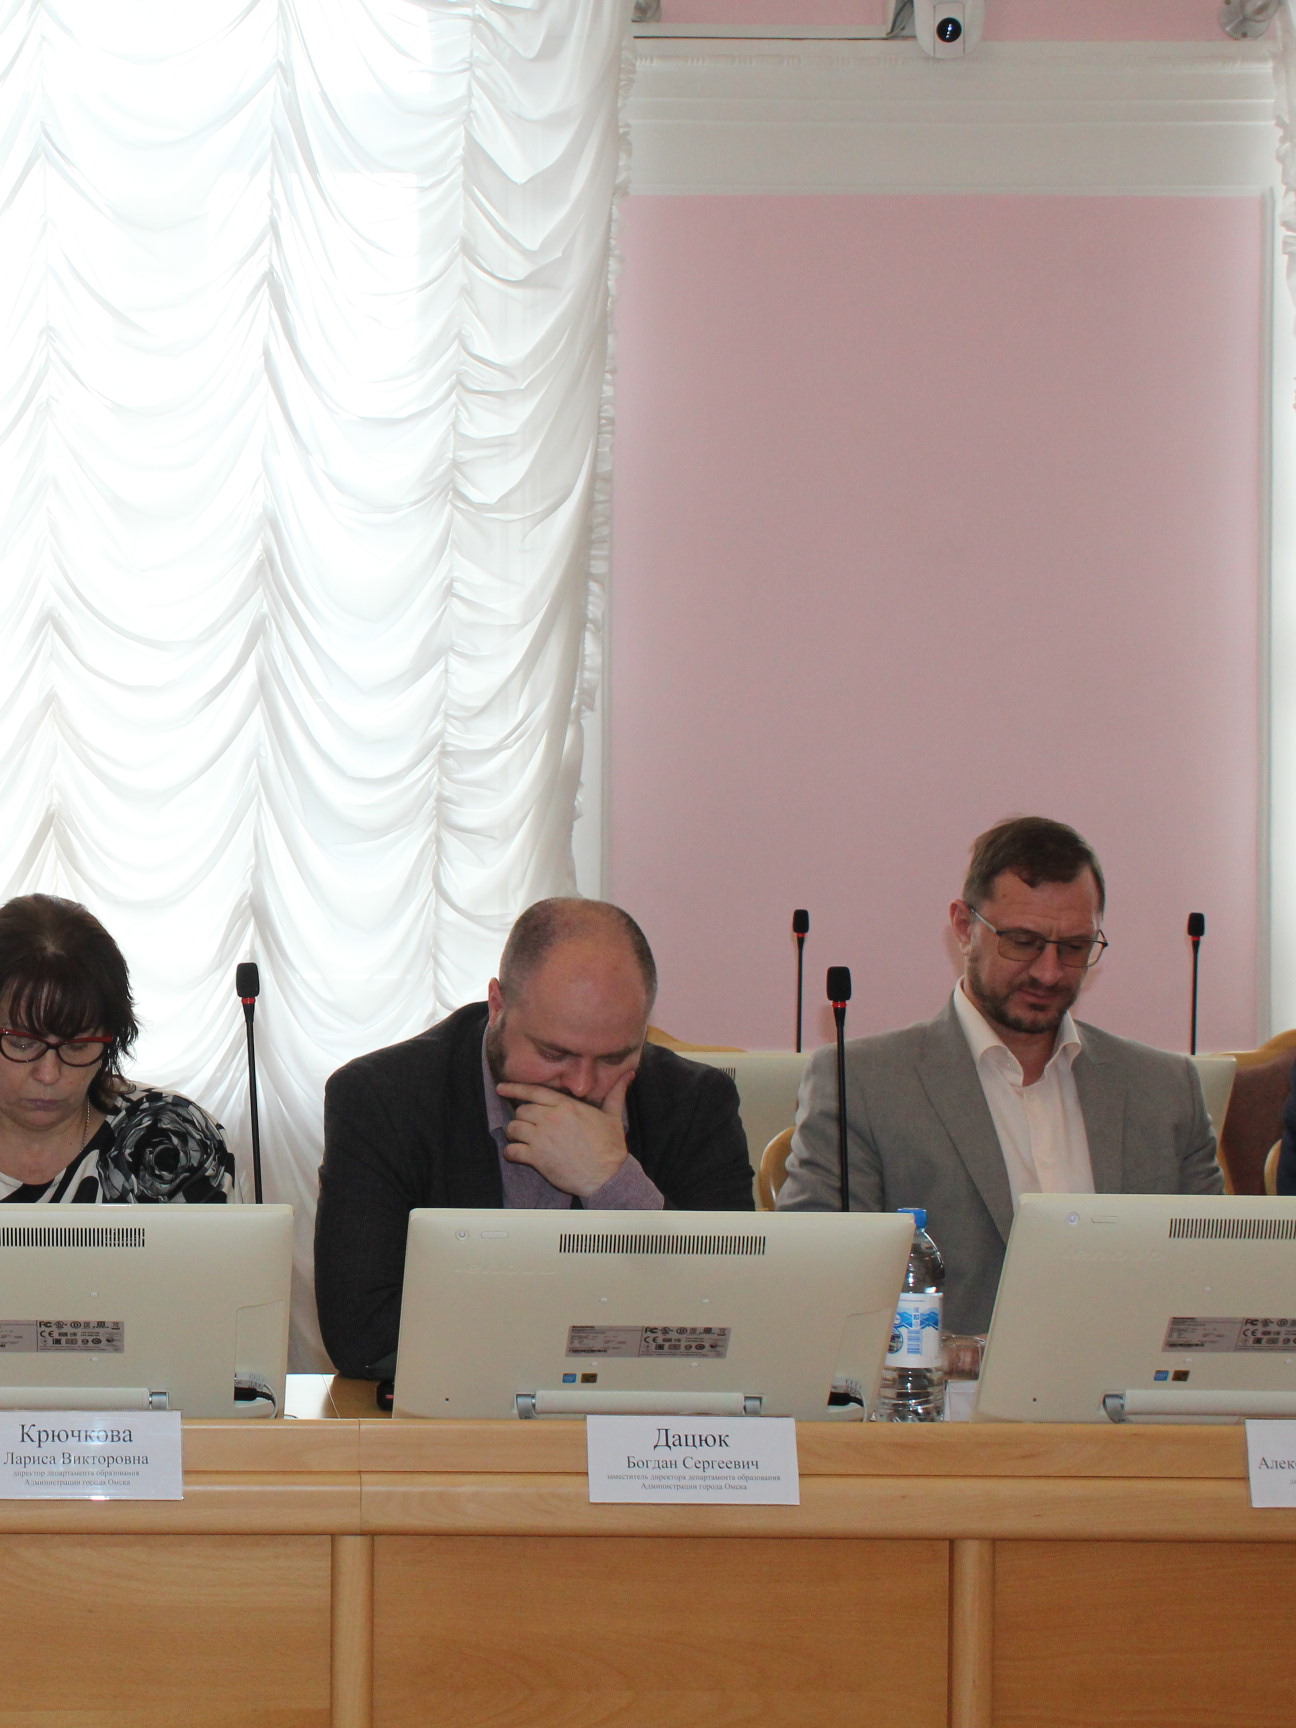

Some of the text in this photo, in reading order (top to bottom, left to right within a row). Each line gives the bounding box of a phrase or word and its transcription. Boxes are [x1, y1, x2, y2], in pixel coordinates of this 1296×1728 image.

[19, 1423, 133, 1448] Крючкова
[653, 1428, 730, 1451] Дацюк
[3, 1452, 149, 1468] Лариса Викторовна
[627, 1455, 759, 1472] Богдан Сергеевич
[1258, 1456, 1296, 1469] Алек
[96, 1469, 140, 1477] образования
[737, 1474, 781, 1482] образования
